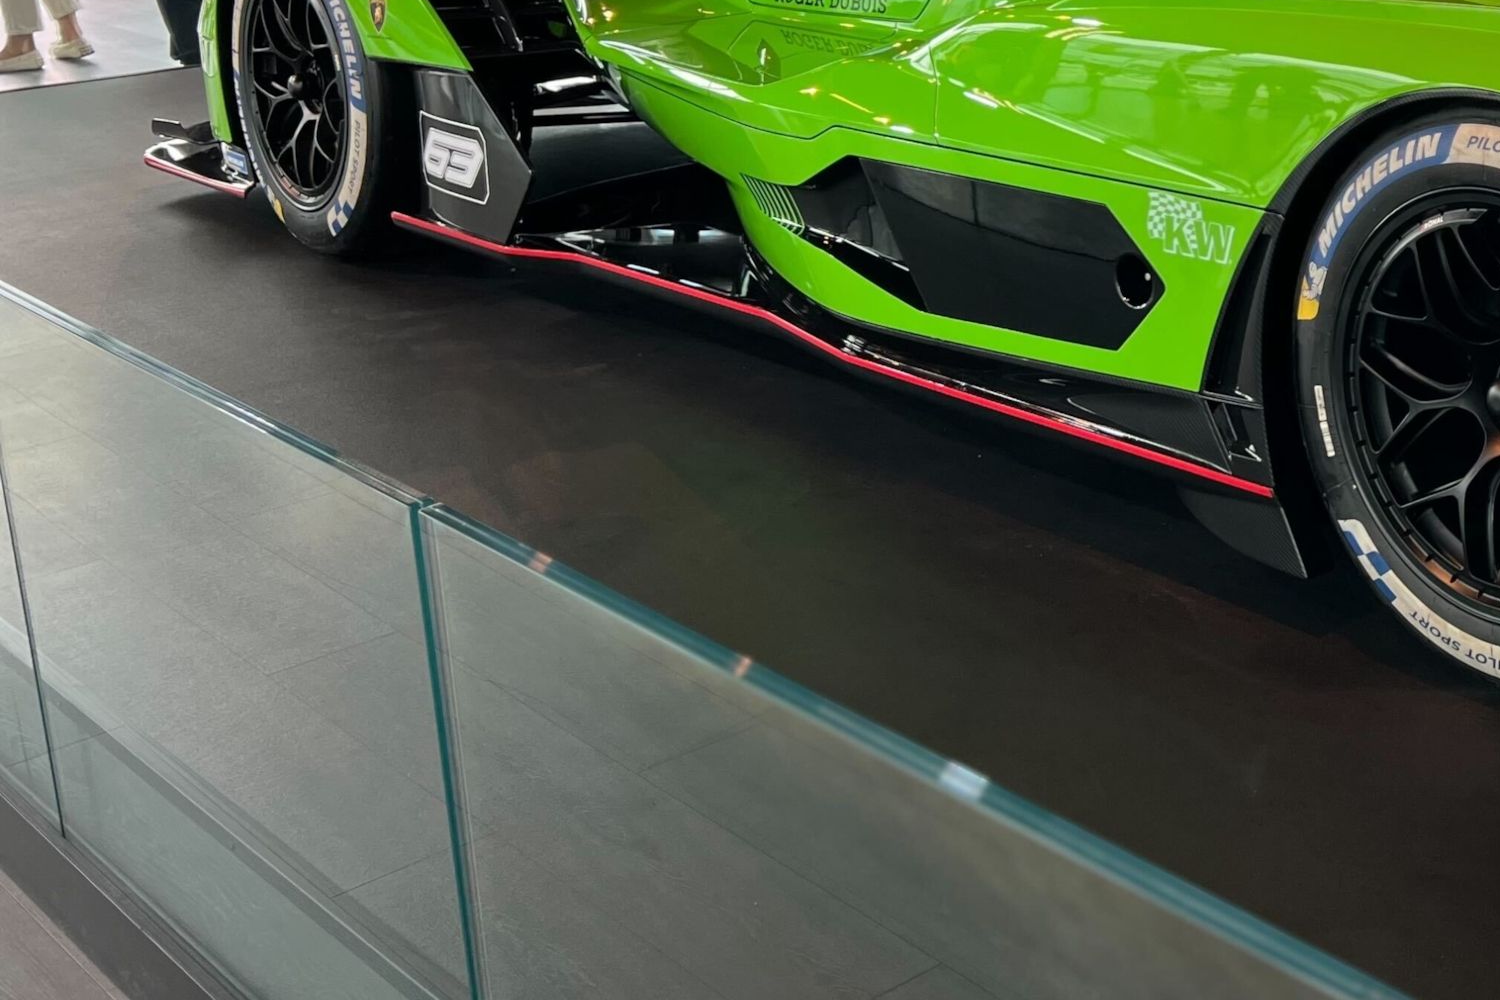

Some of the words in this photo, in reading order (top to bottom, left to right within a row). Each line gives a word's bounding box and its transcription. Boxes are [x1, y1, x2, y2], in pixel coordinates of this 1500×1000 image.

[352, 120, 361, 156] PILOT
[424, 127, 484, 188] 63
[1317, 132, 1442, 258] MICHELIN
[1162, 212, 1236, 265] KW
[1408, 610, 1461, 651] SPORT
